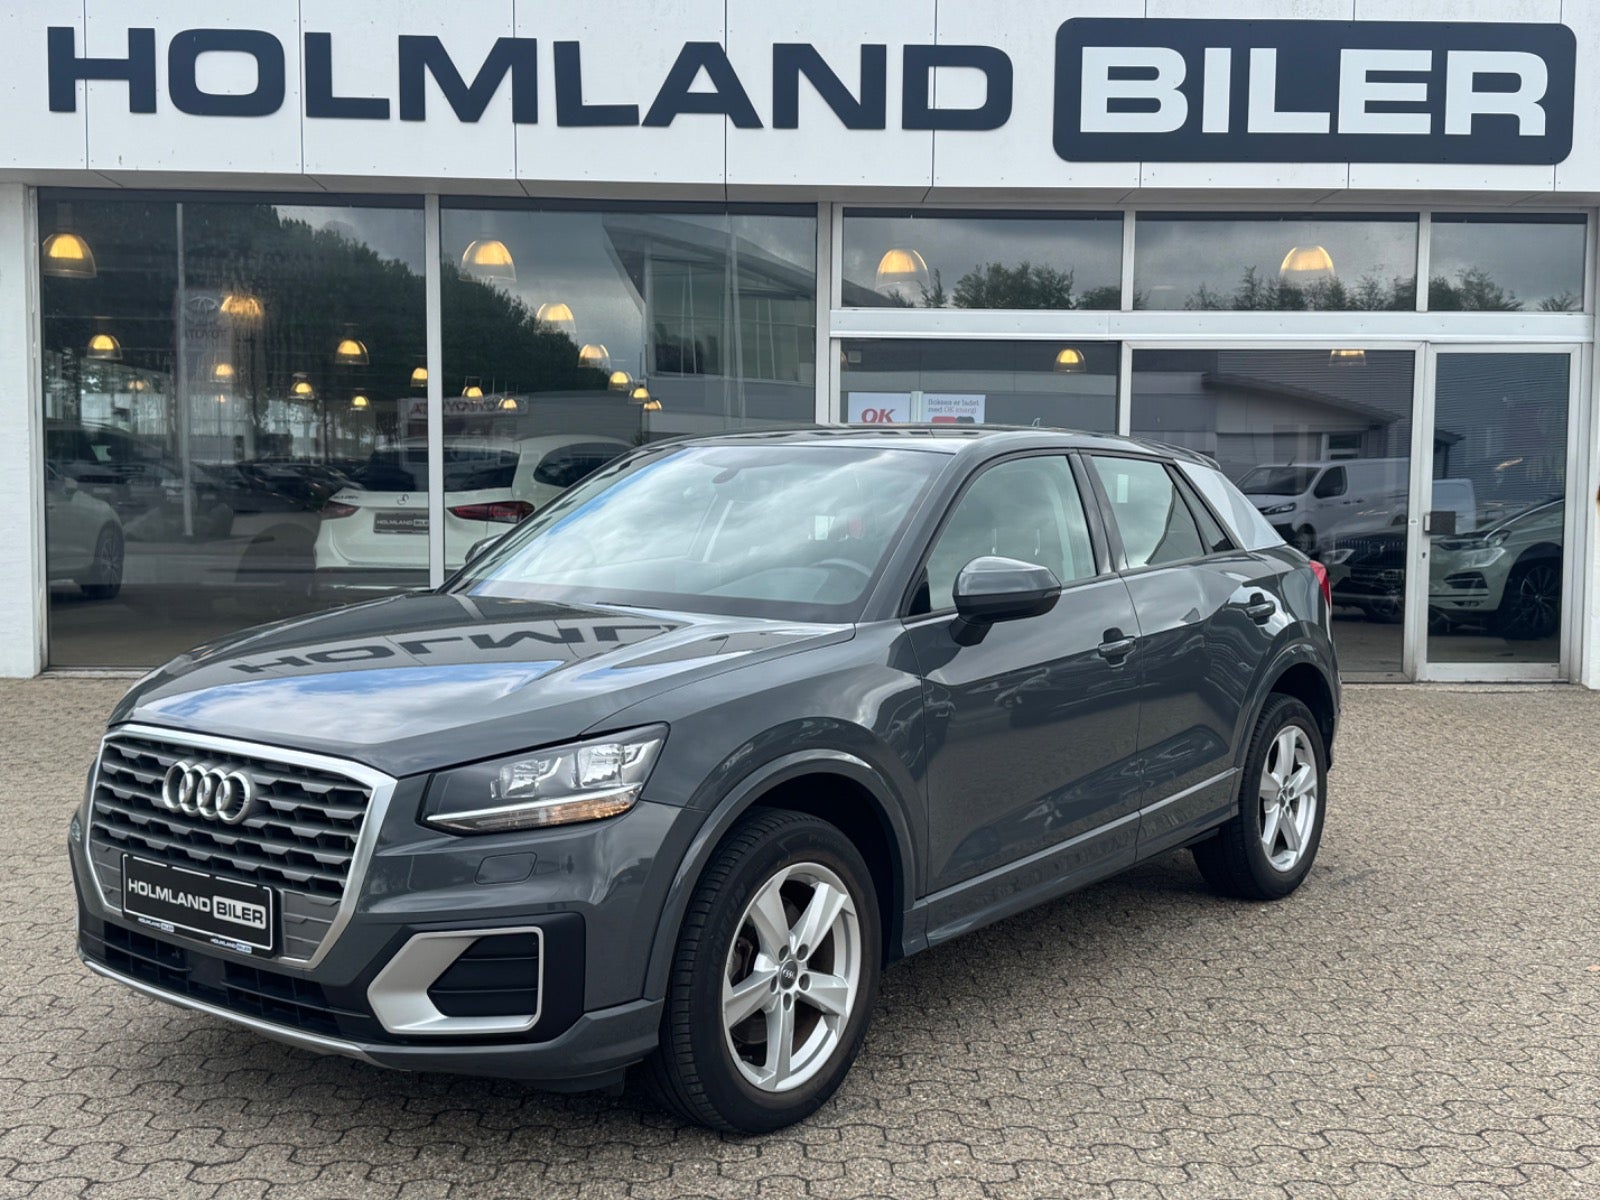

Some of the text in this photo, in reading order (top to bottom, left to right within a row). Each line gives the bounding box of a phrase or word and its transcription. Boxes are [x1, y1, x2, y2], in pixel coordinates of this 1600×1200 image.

[47, 26, 1548, 137] HOLMLAND BILER
[861, 408, 895, 423] OK
[128, 878, 264, 925] HOLMLAND BILER
